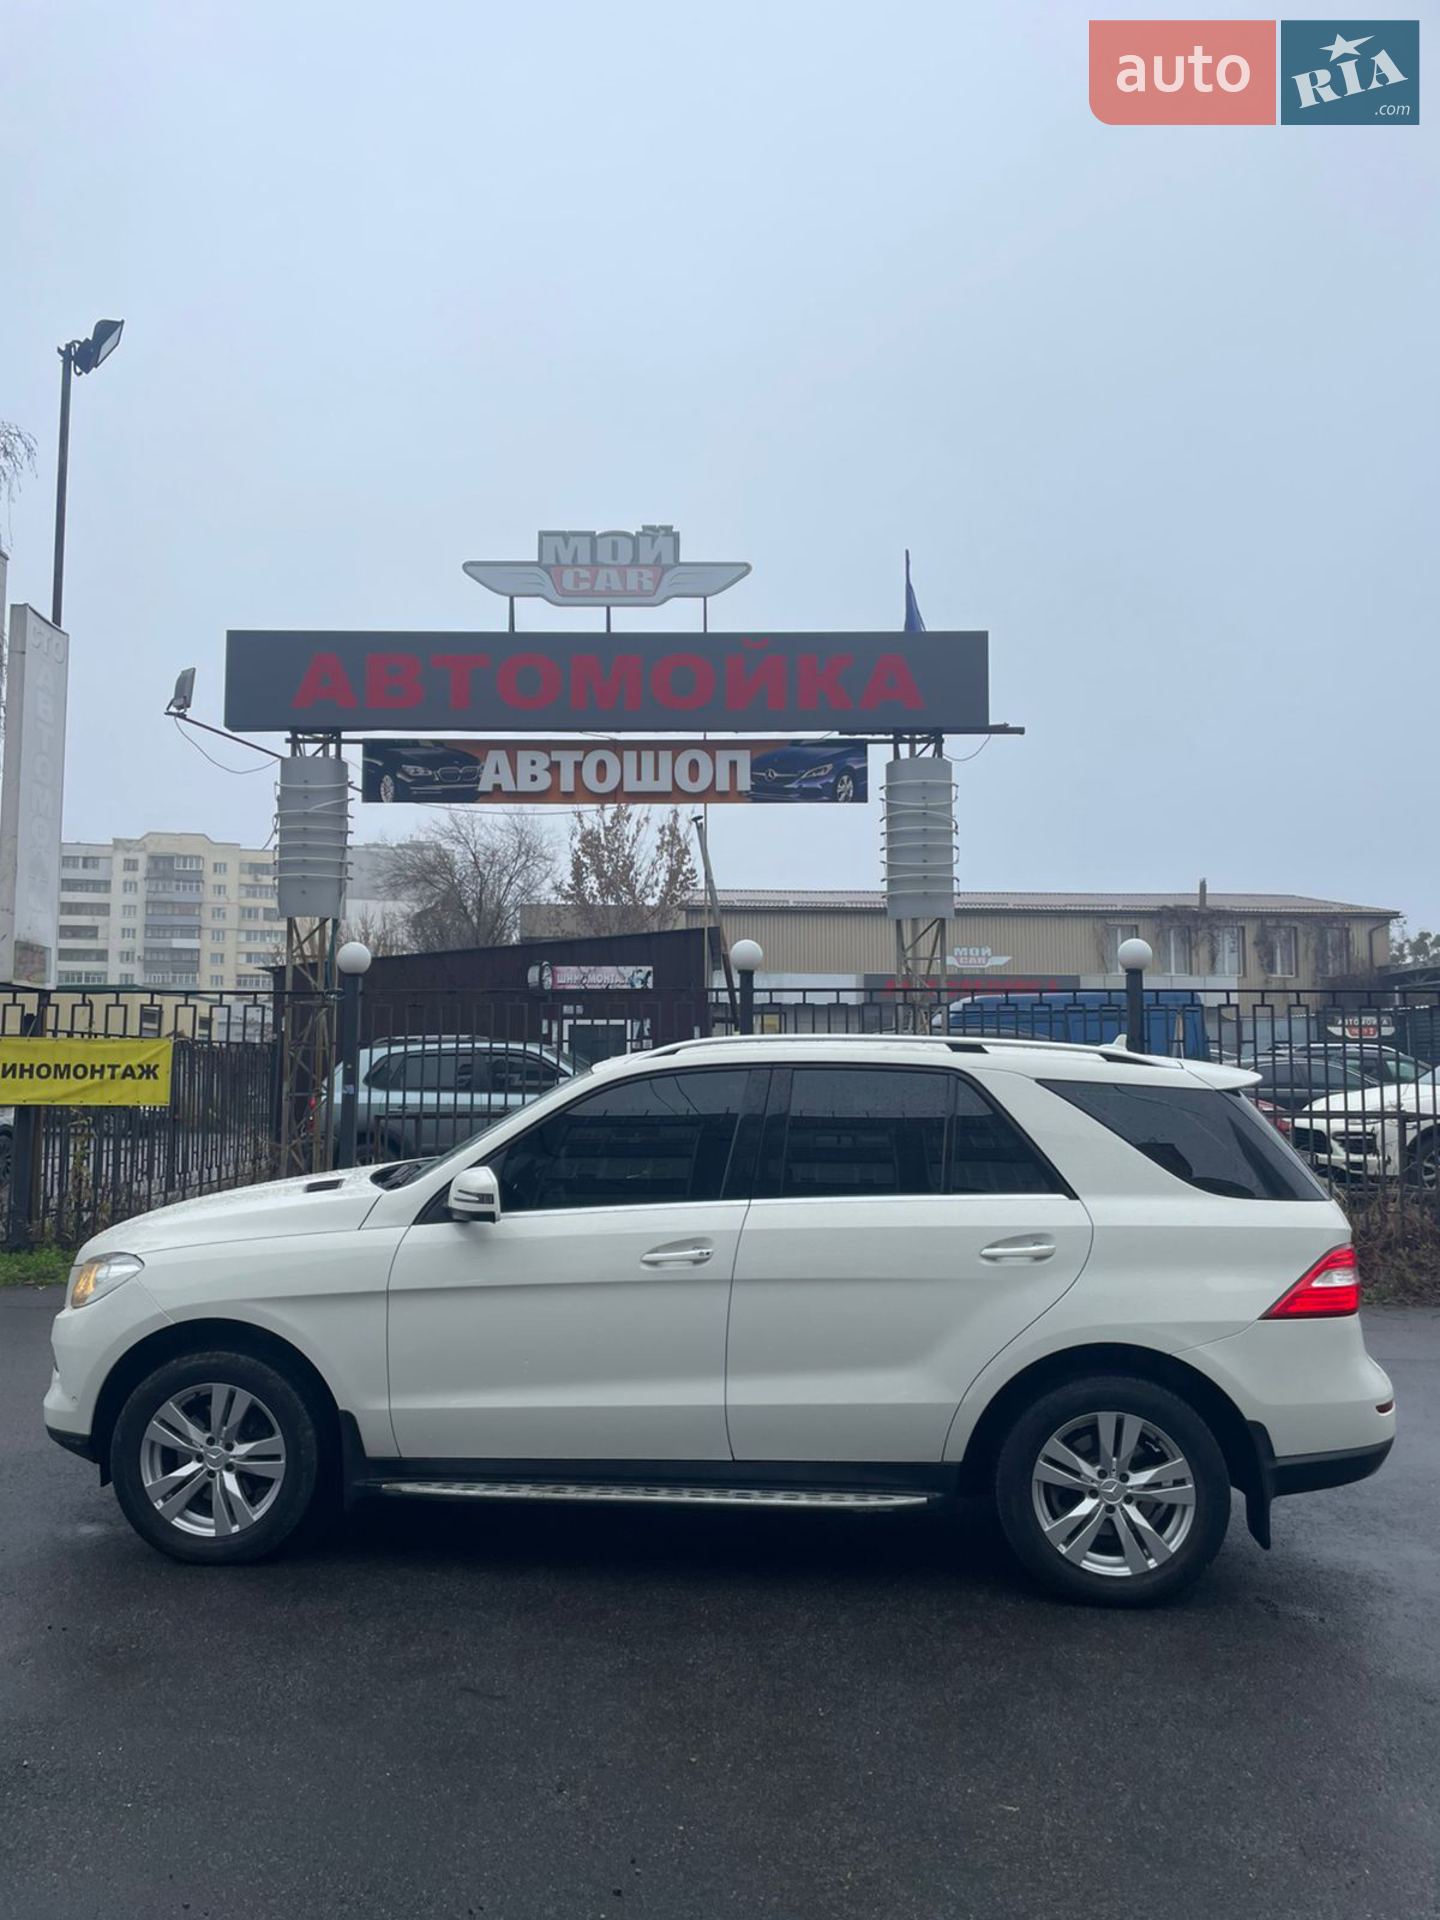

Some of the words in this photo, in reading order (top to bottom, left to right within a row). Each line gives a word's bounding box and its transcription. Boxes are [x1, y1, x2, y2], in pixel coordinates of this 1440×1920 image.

[541, 525, 679, 566] МОЙ
[561, 567, 658, 593] CAR
[291, 638, 926, 711] АВТОМОЙКА
[477, 749, 752, 794] АВТОШОП
